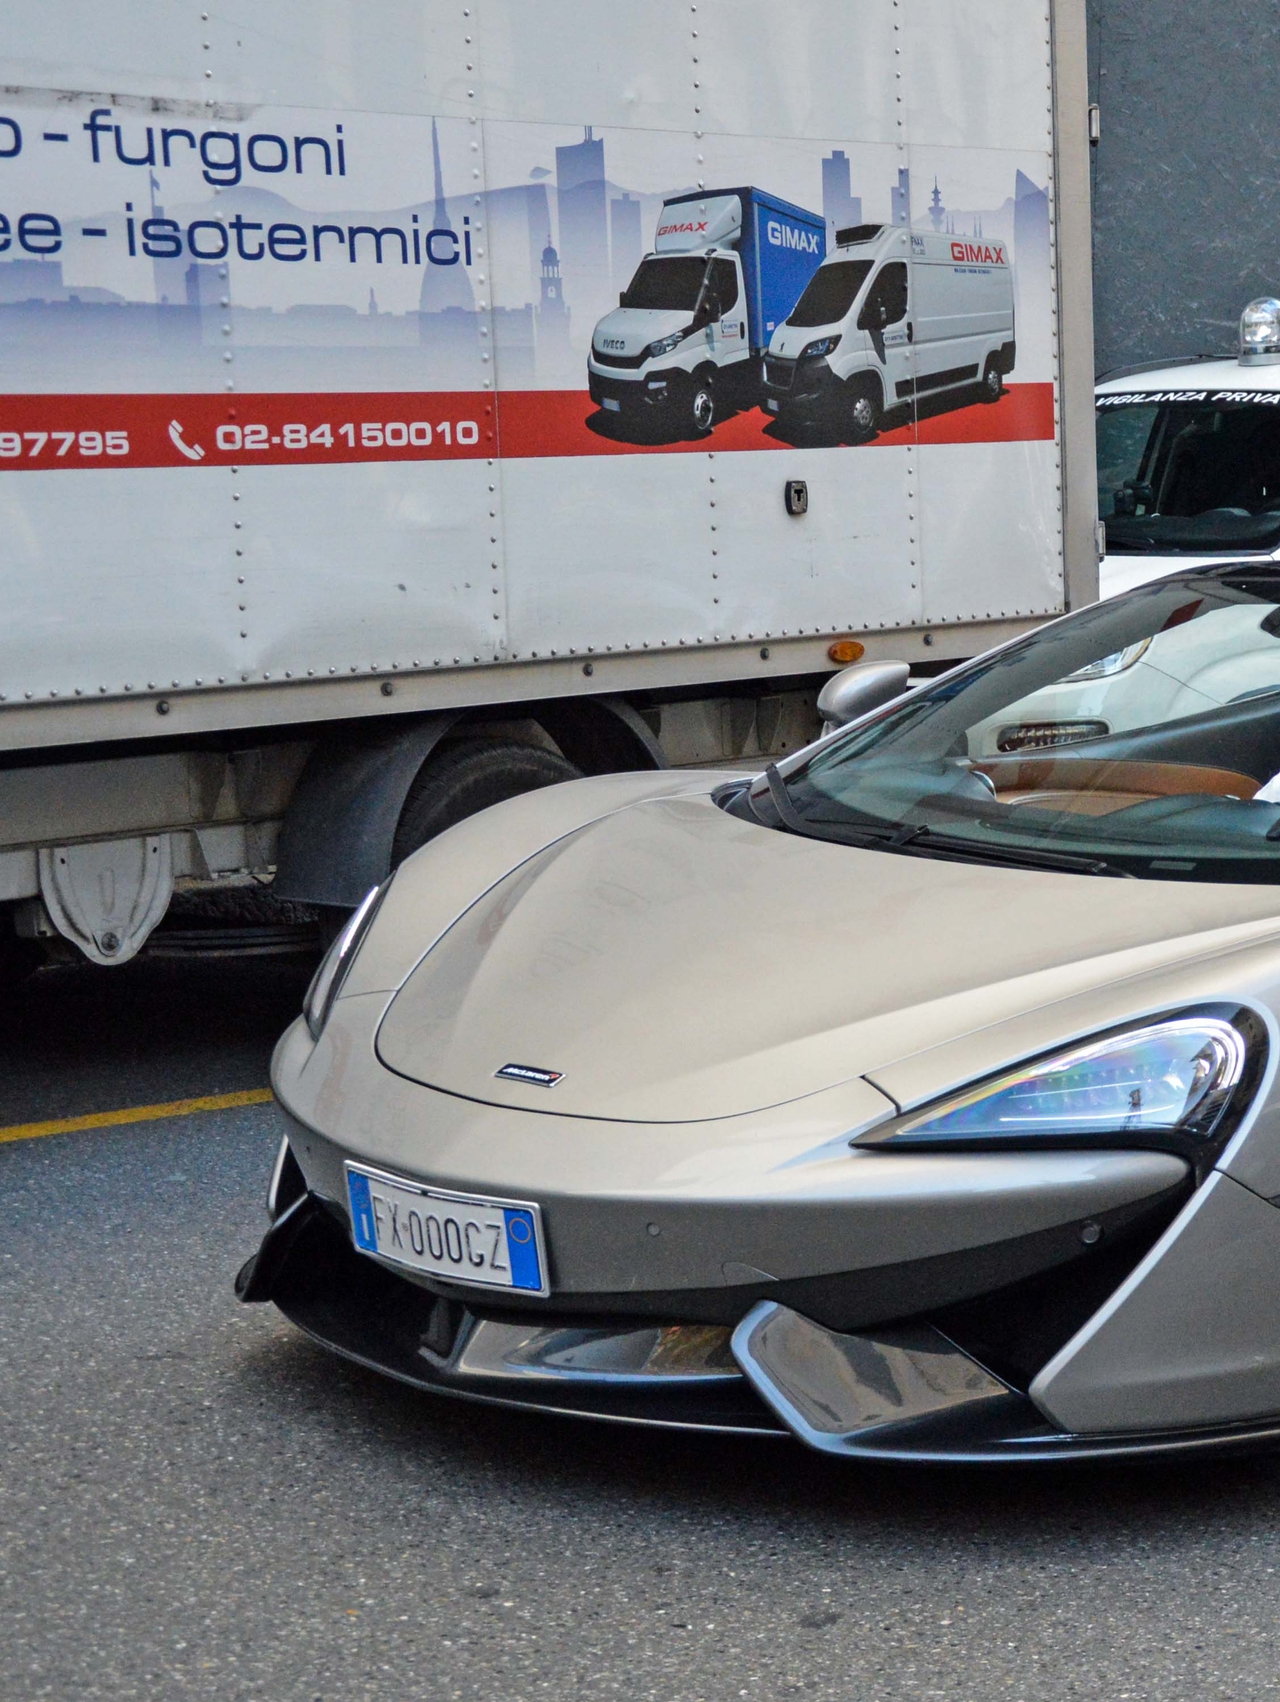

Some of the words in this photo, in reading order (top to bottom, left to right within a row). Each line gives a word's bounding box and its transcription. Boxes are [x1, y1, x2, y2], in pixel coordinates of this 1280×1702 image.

[83, 109, 347, 186] furgoni
[0, 212, 62, 254] e
[125, 202, 473, 266] isotermici
[658, 221, 708, 236] GIMAX
[767, 220, 819, 254] GIMAX
[951, 242, 1005, 264] GIMAX
[602, 338, 625, 350] IVECO
[1096, 391, 1207, 406] VIGILANZA
[216, 420, 479, 451] 02-84150010
[502, 1067, 550, 1080] McLaren
